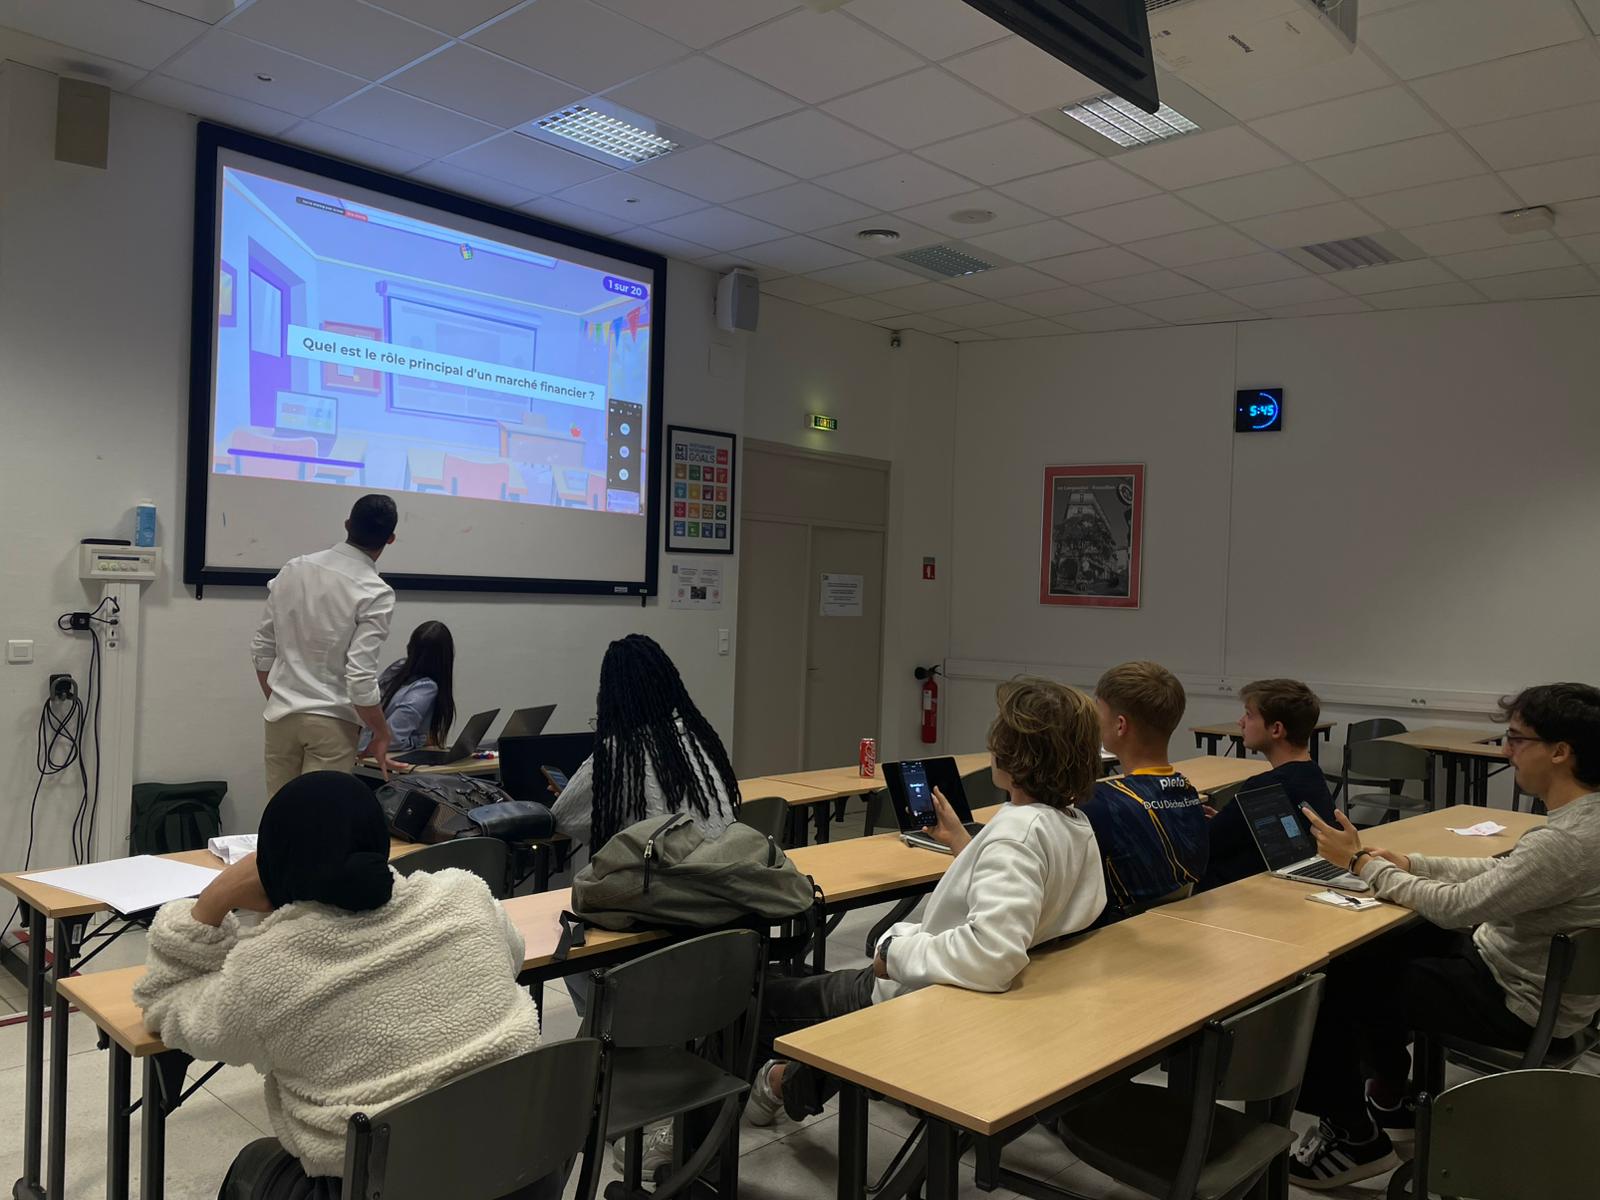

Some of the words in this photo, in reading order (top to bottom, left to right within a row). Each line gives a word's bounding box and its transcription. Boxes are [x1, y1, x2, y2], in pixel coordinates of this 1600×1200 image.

[608, 279, 613, 289] 1
[614, 283, 629, 293] sur
[631, 285, 642, 296] 20
[302, 337, 336, 353] Quel
[340, 346, 361, 358] est
[365, 348, 377, 361] le
[380, 352, 406, 366] rôle
[409, 358, 463, 376] principal
[466, 368, 492, 381] d'un
[495, 375, 538, 390] marché
[540, 381, 587, 399] financier
[588, 390, 595, 400] ?
[1249, 405, 1274, 417] 5:45
